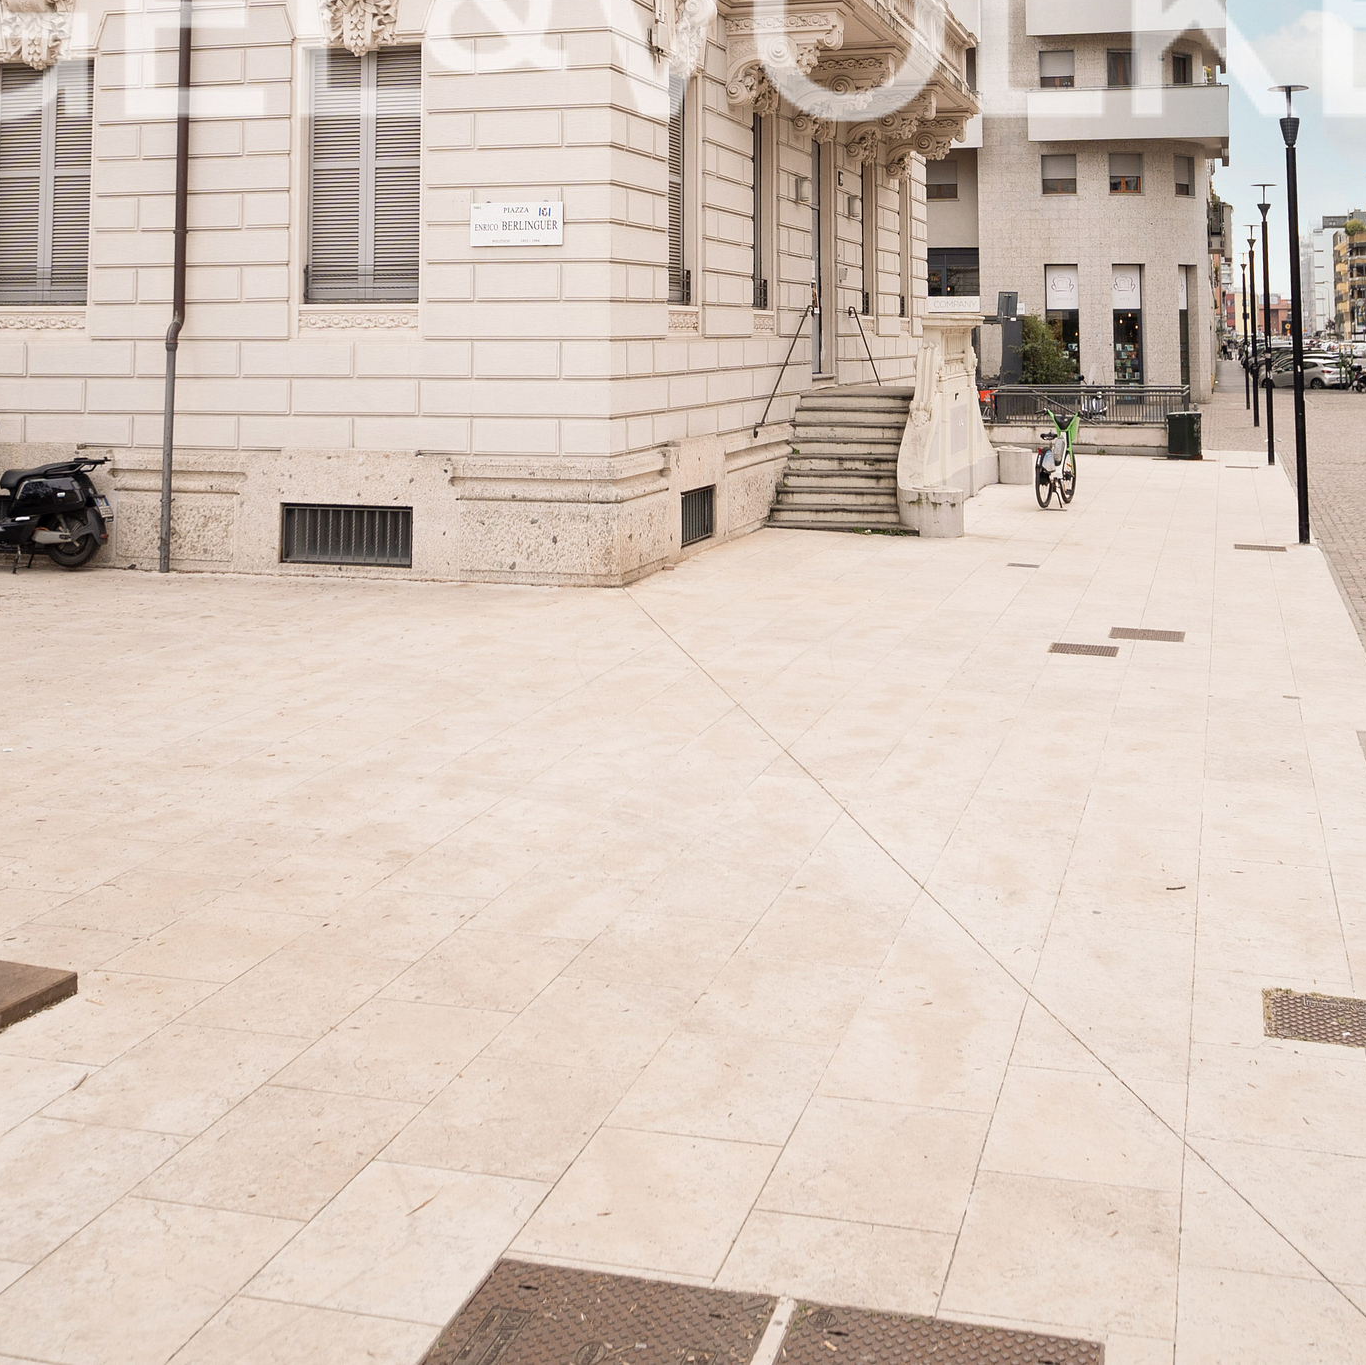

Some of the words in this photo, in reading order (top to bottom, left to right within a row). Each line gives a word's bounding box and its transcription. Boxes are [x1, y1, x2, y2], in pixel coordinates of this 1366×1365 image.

[475, 223, 499, 231] ENRICO
[502, 220, 558, 231] BERLINGUER
[933, 300, 978, 309] COMPANY
